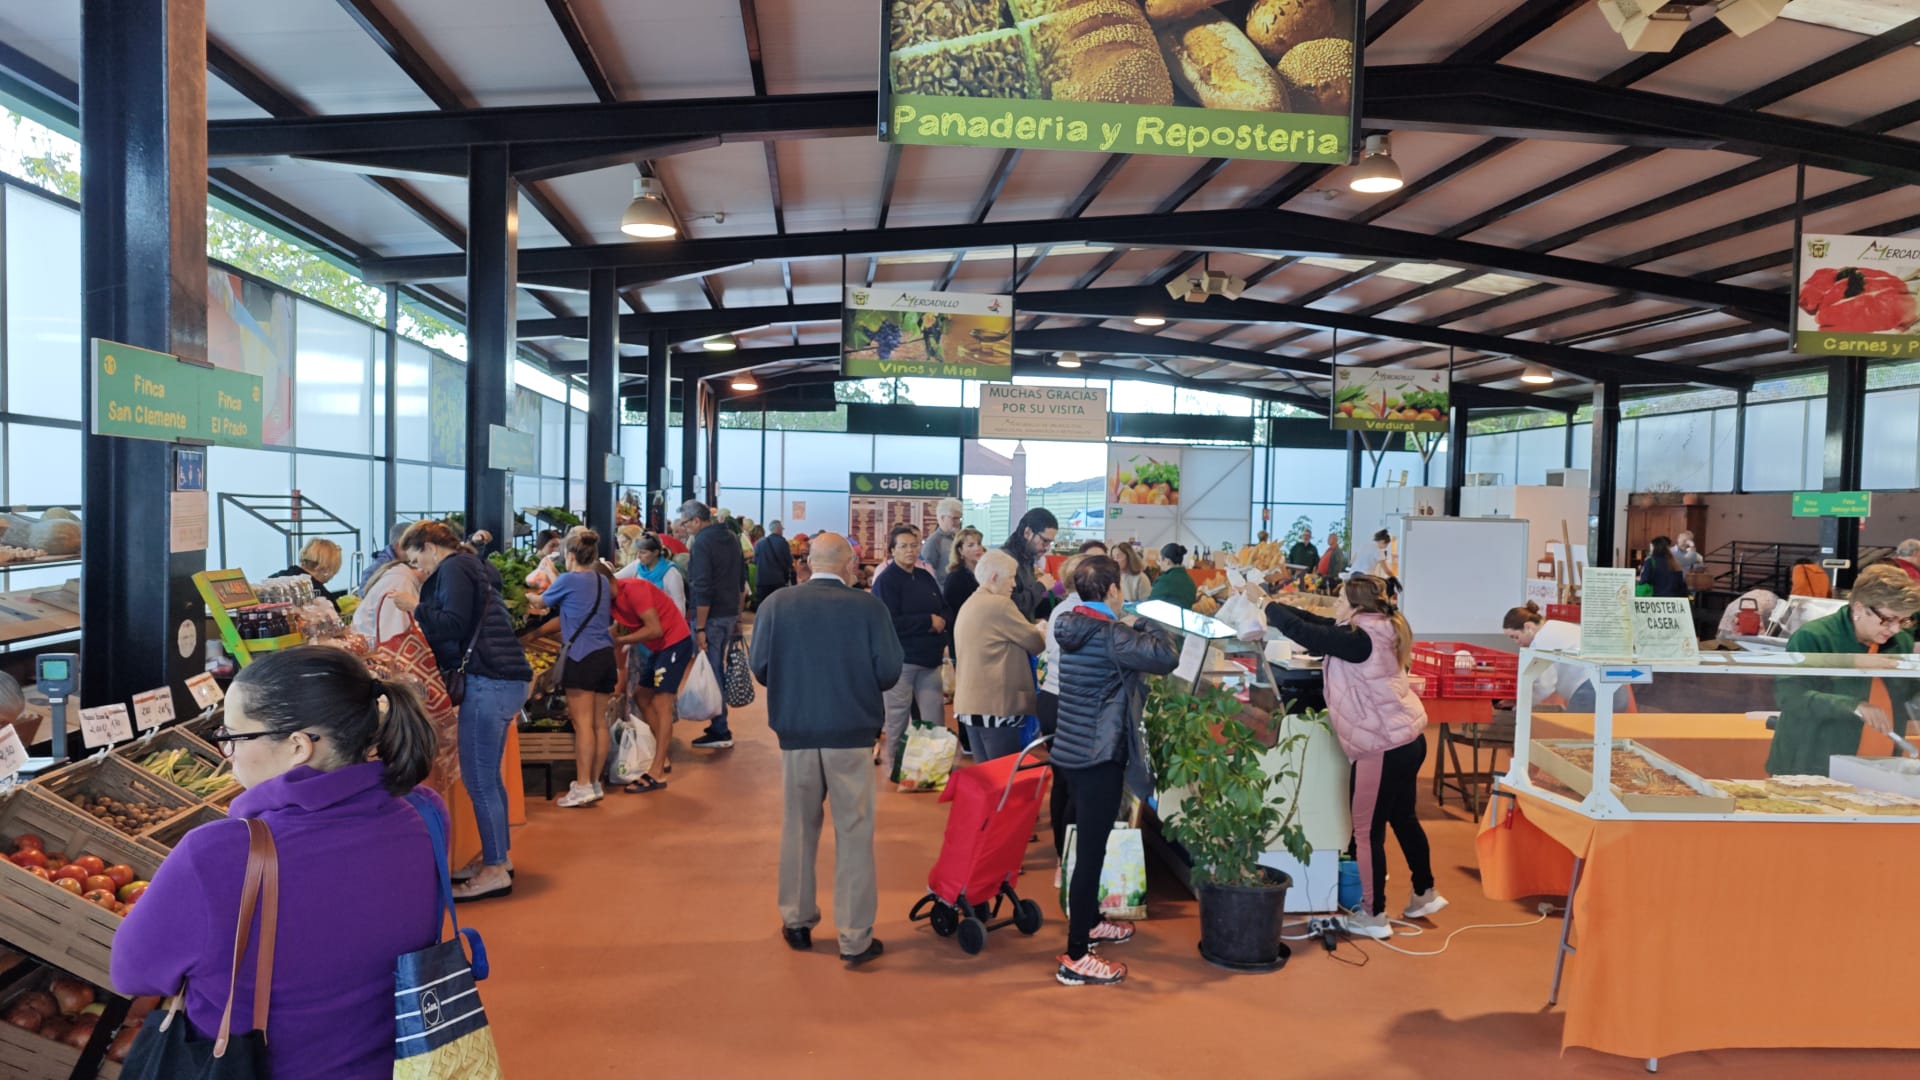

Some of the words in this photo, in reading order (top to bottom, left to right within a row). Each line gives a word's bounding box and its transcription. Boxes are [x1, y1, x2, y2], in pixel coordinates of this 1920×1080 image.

[893, 105, 1088, 142] Panaderia
[1099, 122, 1122, 150] y
[1136, 116, 1339, 155] Reposteria
[1823, 337, 1888, 352] Carnes
[1892, 343, 1903, 355] y
[878, 361, 925, 375] Vinos
[928, 367, 938, 376] y
[943, 365, 978, 377] Miel
[133, 373, 166, 399] Finca
[989, 387, 1042, 399] MUCHAS
[1046, 389, 1098, 401] GRACIAS
[217, 390, 242, 412] Finca
[1002, 403, 1026, 413] POR
[1030, 404, 1046, 414] SU
[1049, 405, 1085, 415] VISITA
[108, 400, 132, 422] San
[135, 405, 187, 430] Clemente
[211, 417, 221, 434] El
[223, 418, 248, 436] Prado
[1366, 420, 1415, 431] Verduras
[879, 476, 950, 492] cajasiete
[1647, 617, 1680, 630] CASERA
